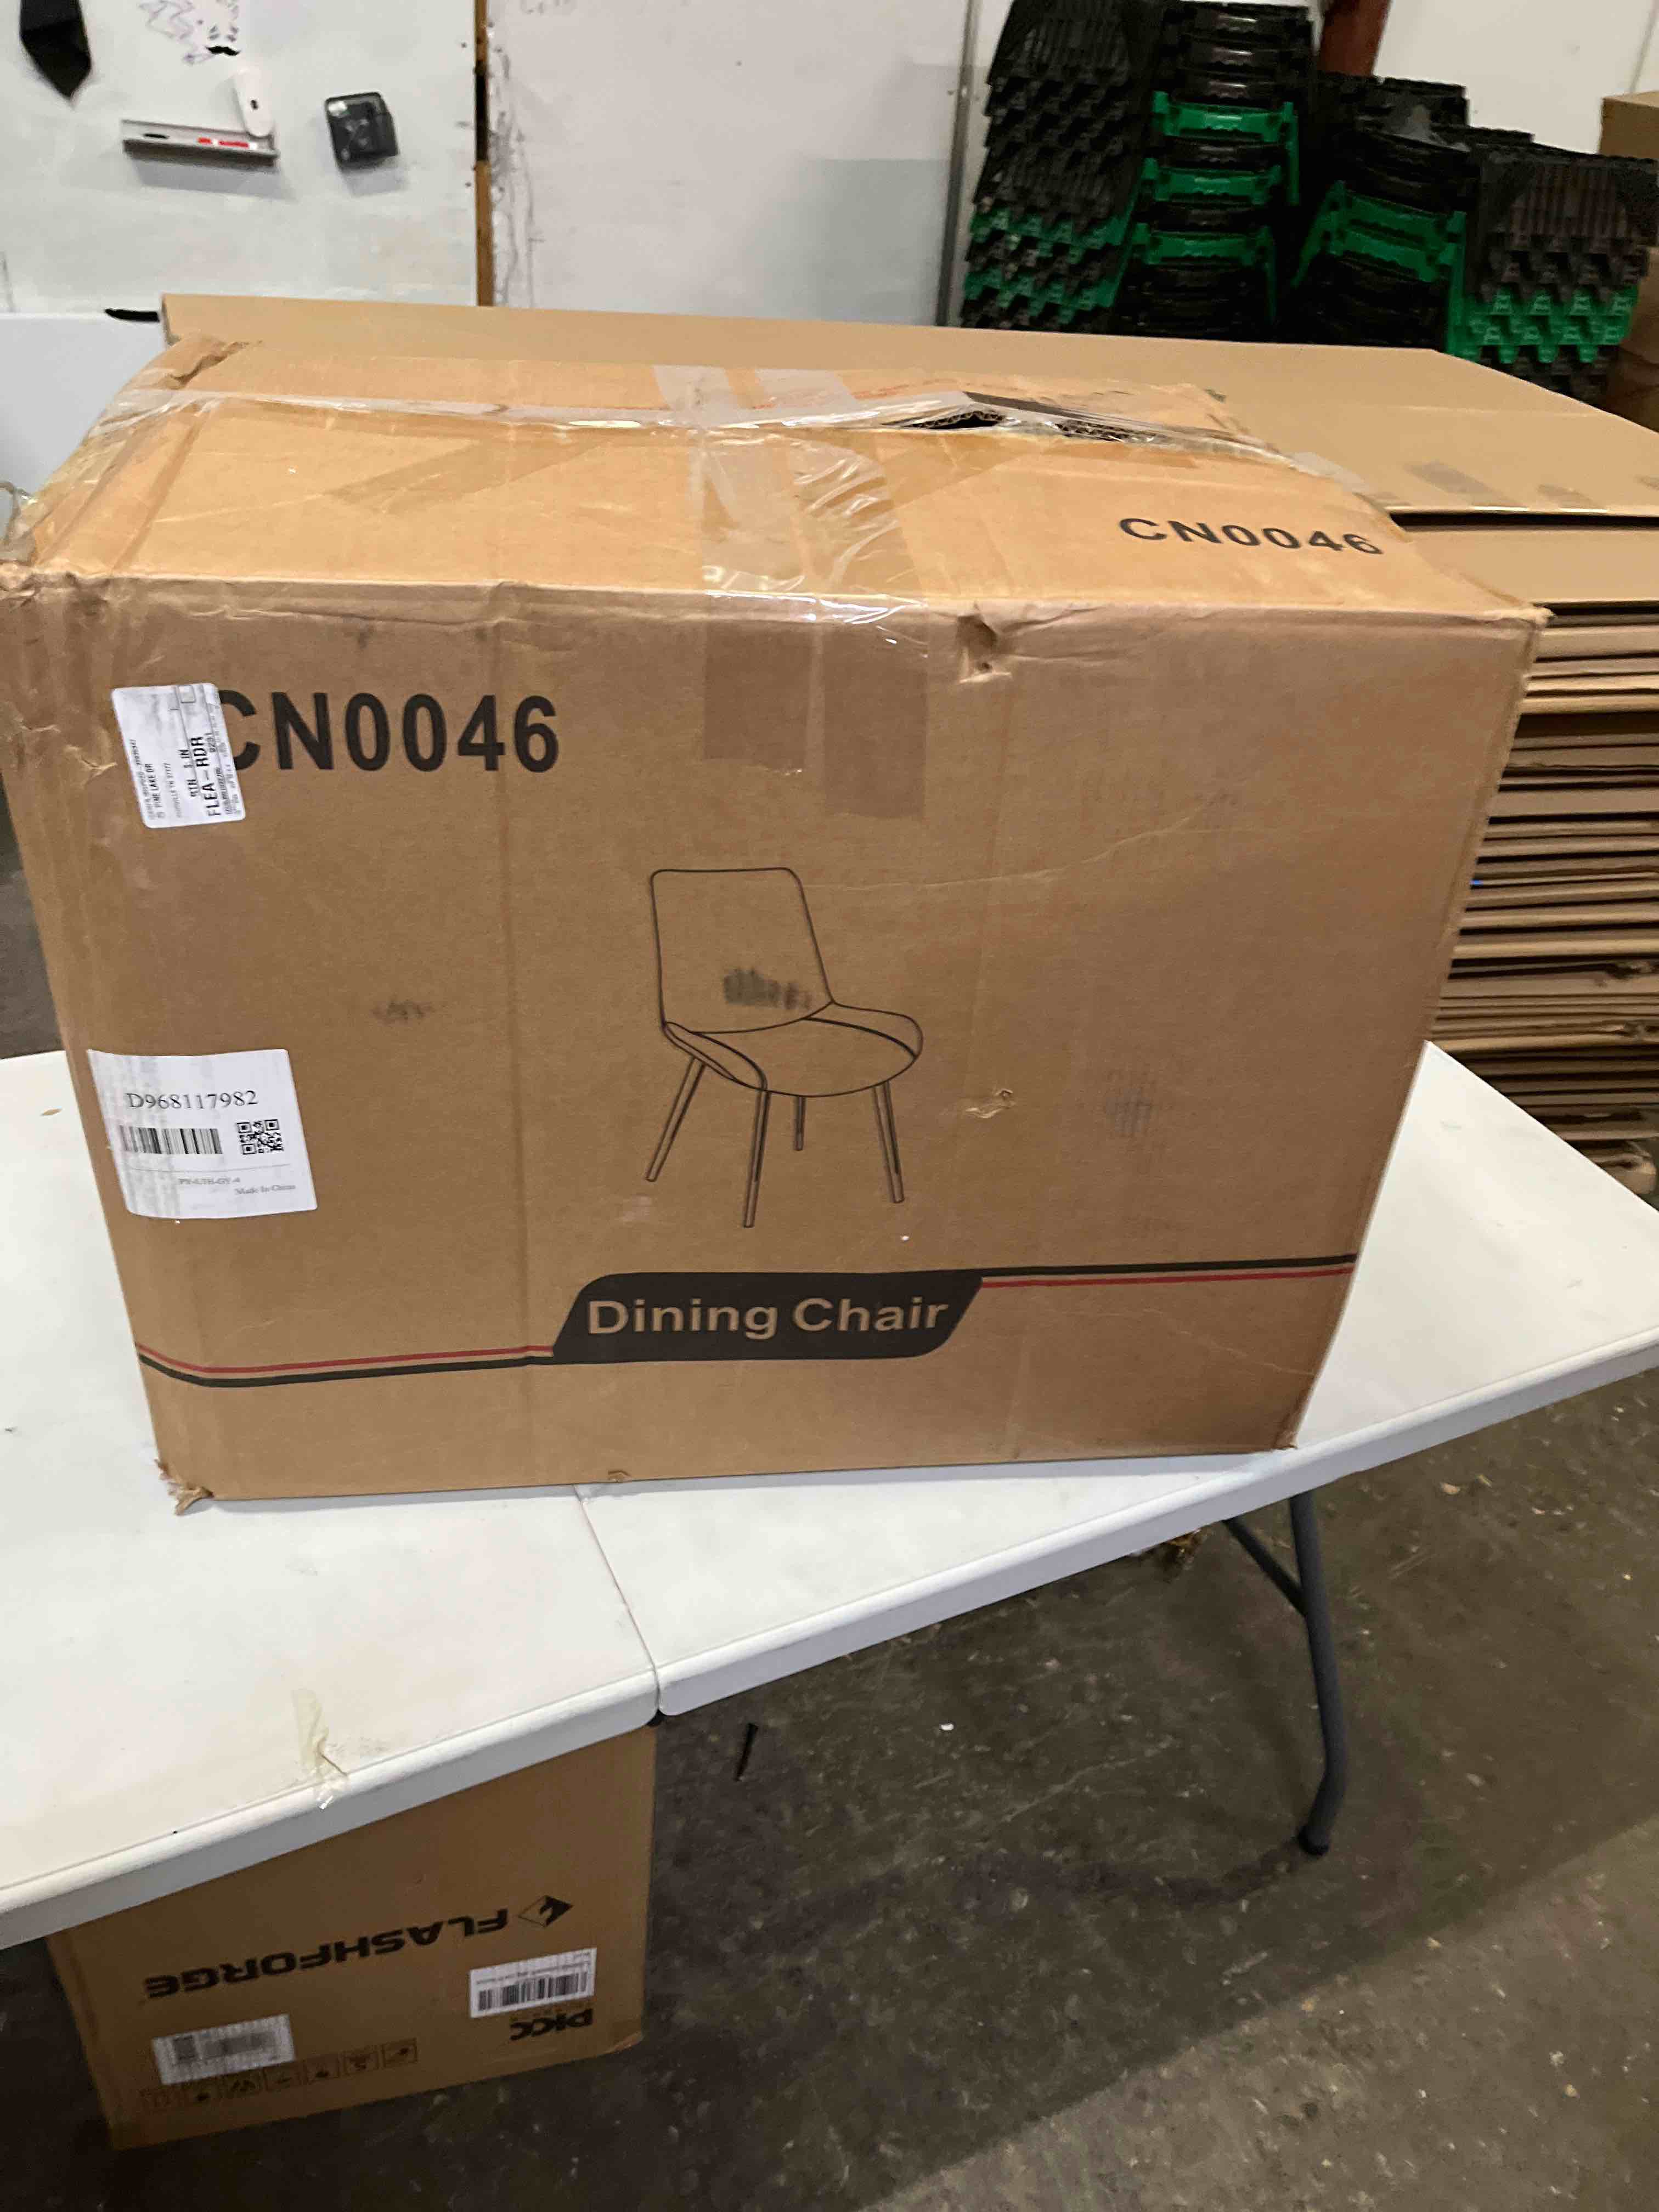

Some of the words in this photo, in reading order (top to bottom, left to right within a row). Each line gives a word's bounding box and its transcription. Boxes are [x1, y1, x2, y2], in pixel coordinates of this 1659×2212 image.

[1119, 518, 1384, 555] CN0046
[218, 690, 559, 772] CN0046
[147, 776, 158, 791] LAKE
[126, 1091, 258, 1109] D968117982
[588, 1299, 778, 1340] Dining
[792, 1296, 950, 1332] Chair
[143, 1909, 508, 1999] FLASHFORGE
